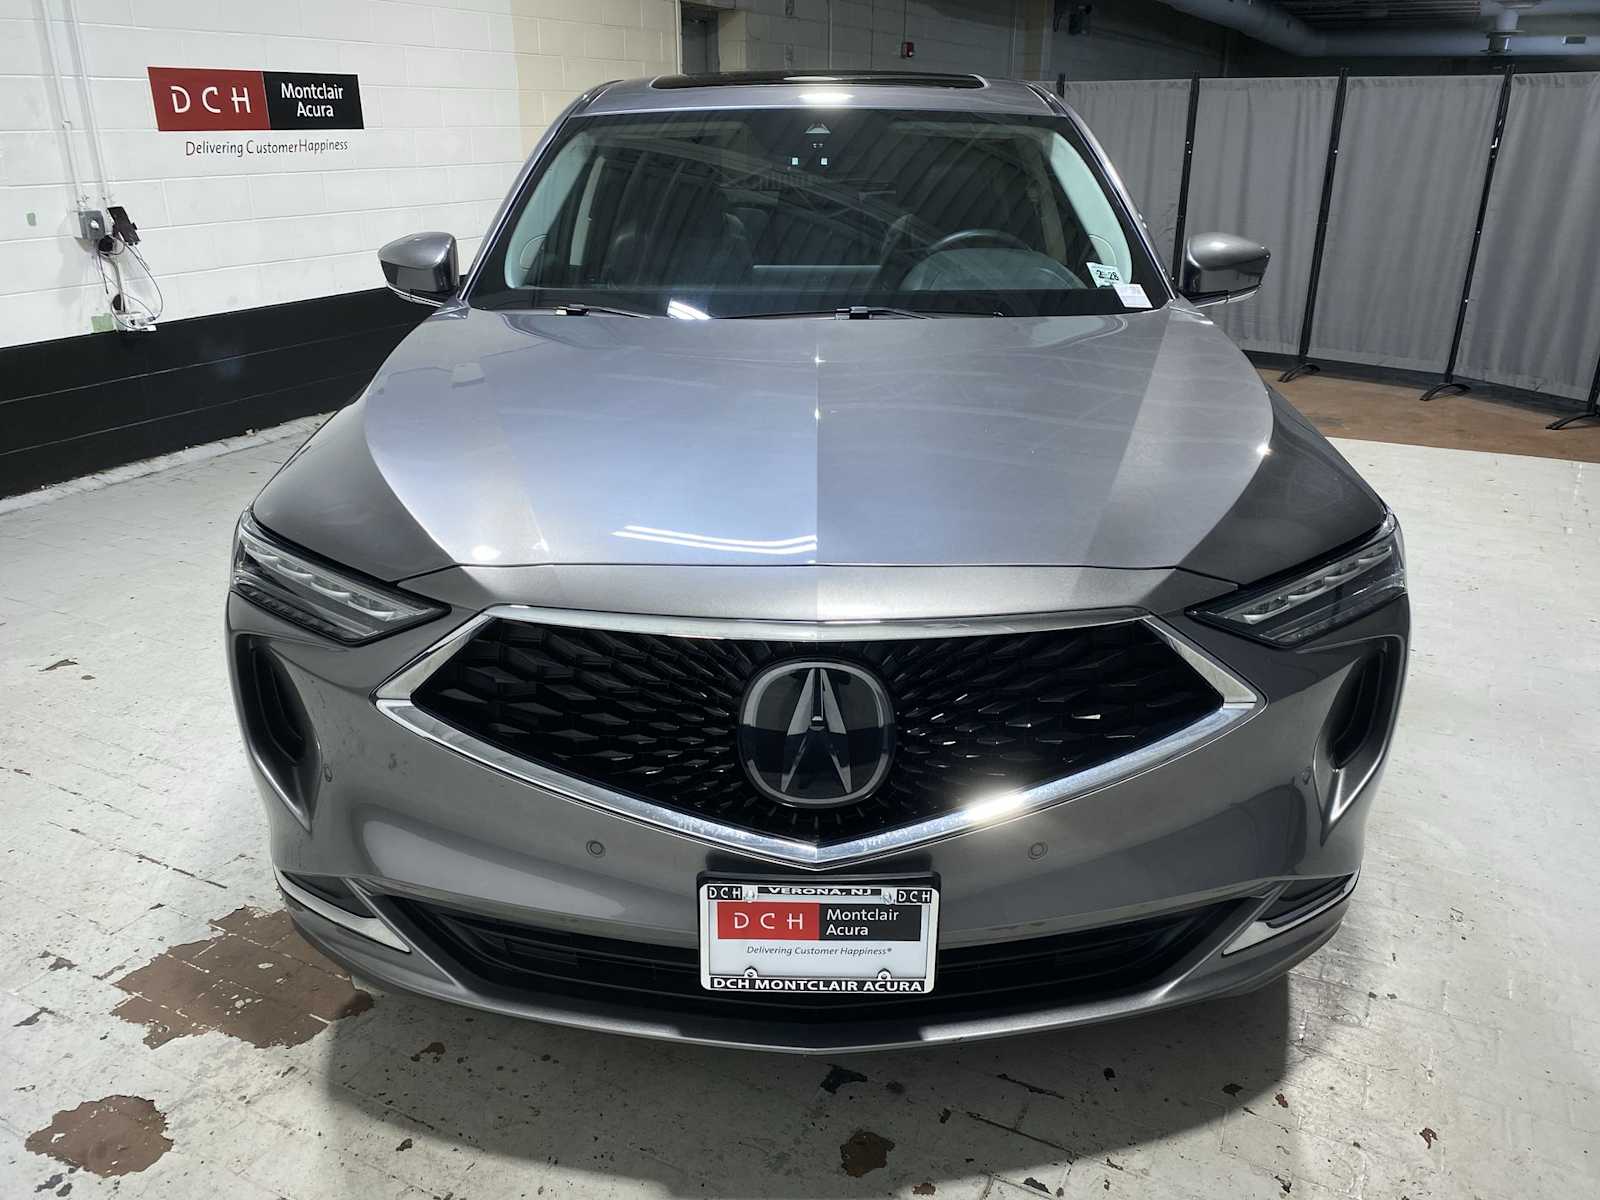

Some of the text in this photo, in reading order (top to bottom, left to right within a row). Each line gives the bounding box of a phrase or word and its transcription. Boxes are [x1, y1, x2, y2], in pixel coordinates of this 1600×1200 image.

[281, 82, 344, 100] Montclair
[296, 102, 335, 117] Acura
[185, 139, 348, 157] Delivering Customer Happiness
[768, 886, 872, 896] VERONA, NJ
[826, 908, 899, 921] Montclair
[826, 924, 869, 936] Acura
[747, 946, 792, 956] Delivering
[794, 946, 839, 955] Customer
[713, 978, 922, 992] DCH MONTCLAIR ACURA
